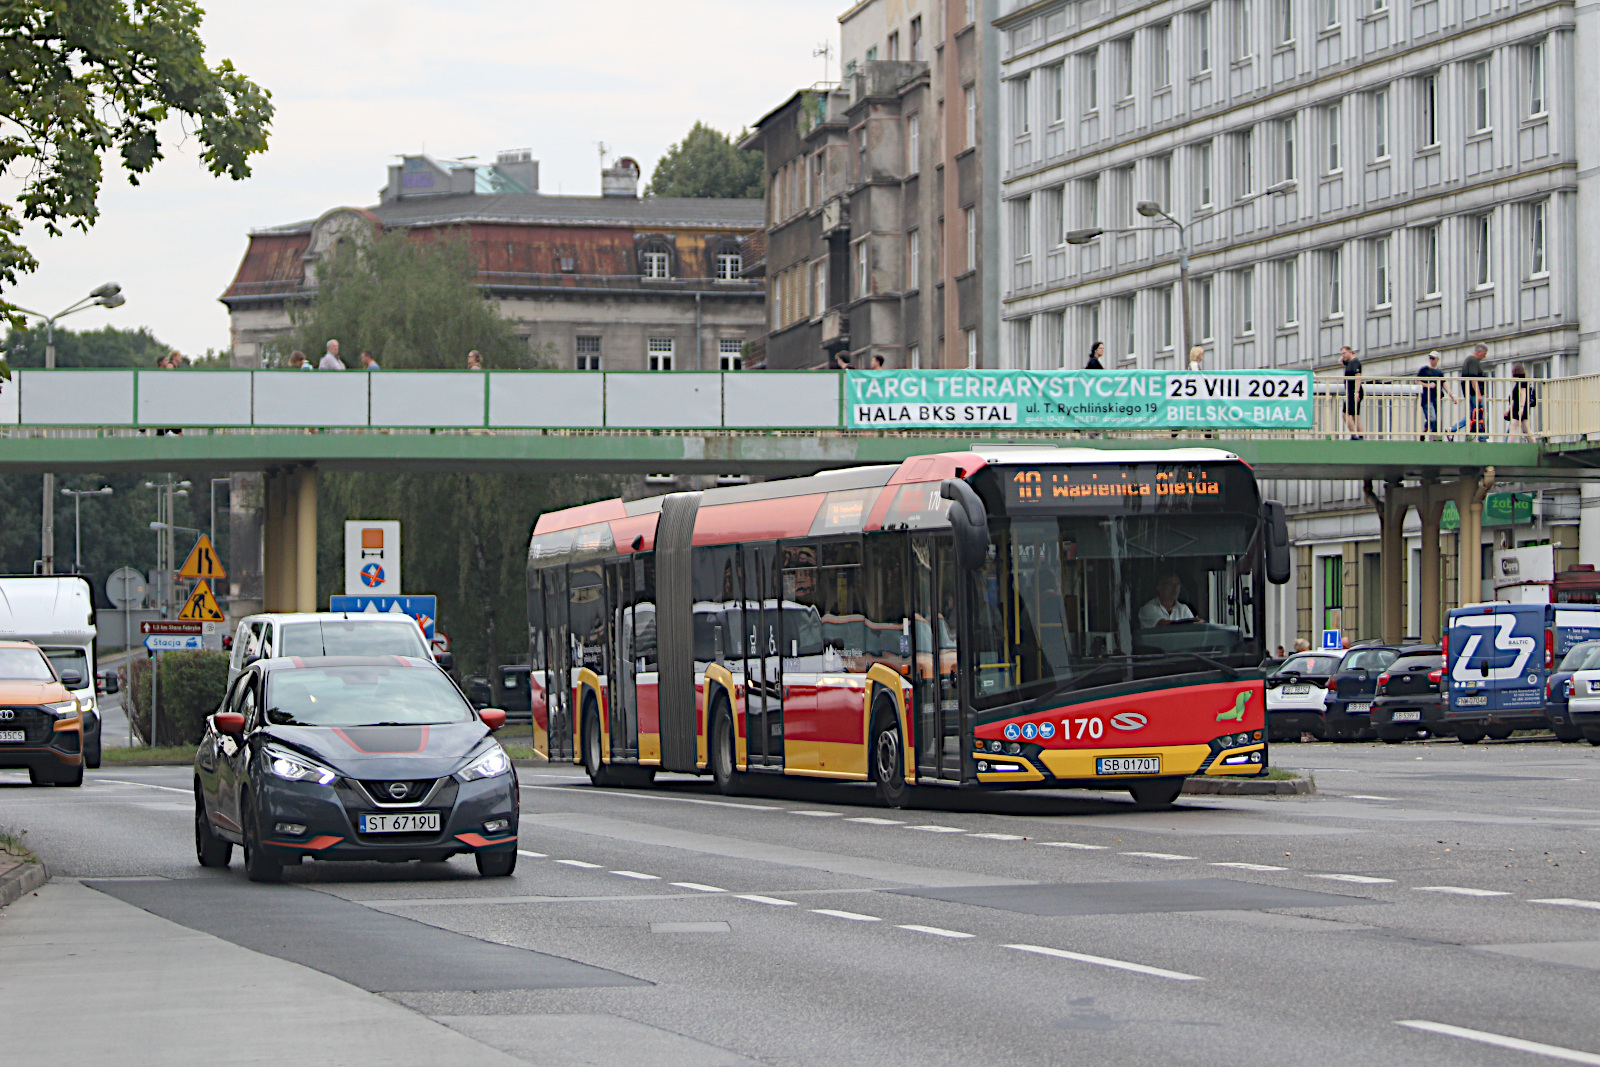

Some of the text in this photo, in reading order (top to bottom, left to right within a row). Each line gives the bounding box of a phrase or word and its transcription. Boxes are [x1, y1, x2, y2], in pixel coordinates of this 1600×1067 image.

[852, 376, 1161, 398] TARGI TERRARYSTYCZNE
[1171, 378, 1304, 397] 25 VIII 2024
[859, 406, 1012, 422] HALA BKS STAL
[1026, 402, 1157, 416] ul. T. Rychlińskiego 19
[1167, 405, 1307, 421] BIELSKO-BIAŁA
[153, 637, 181, 648] Stacja
[1327, 633, 1335, 647] L
[1060, 717, 1104, 740] 170
[1104, 758, 1157, 771] SB 0170T
[369, 815, 436, 830] ST 6719U
